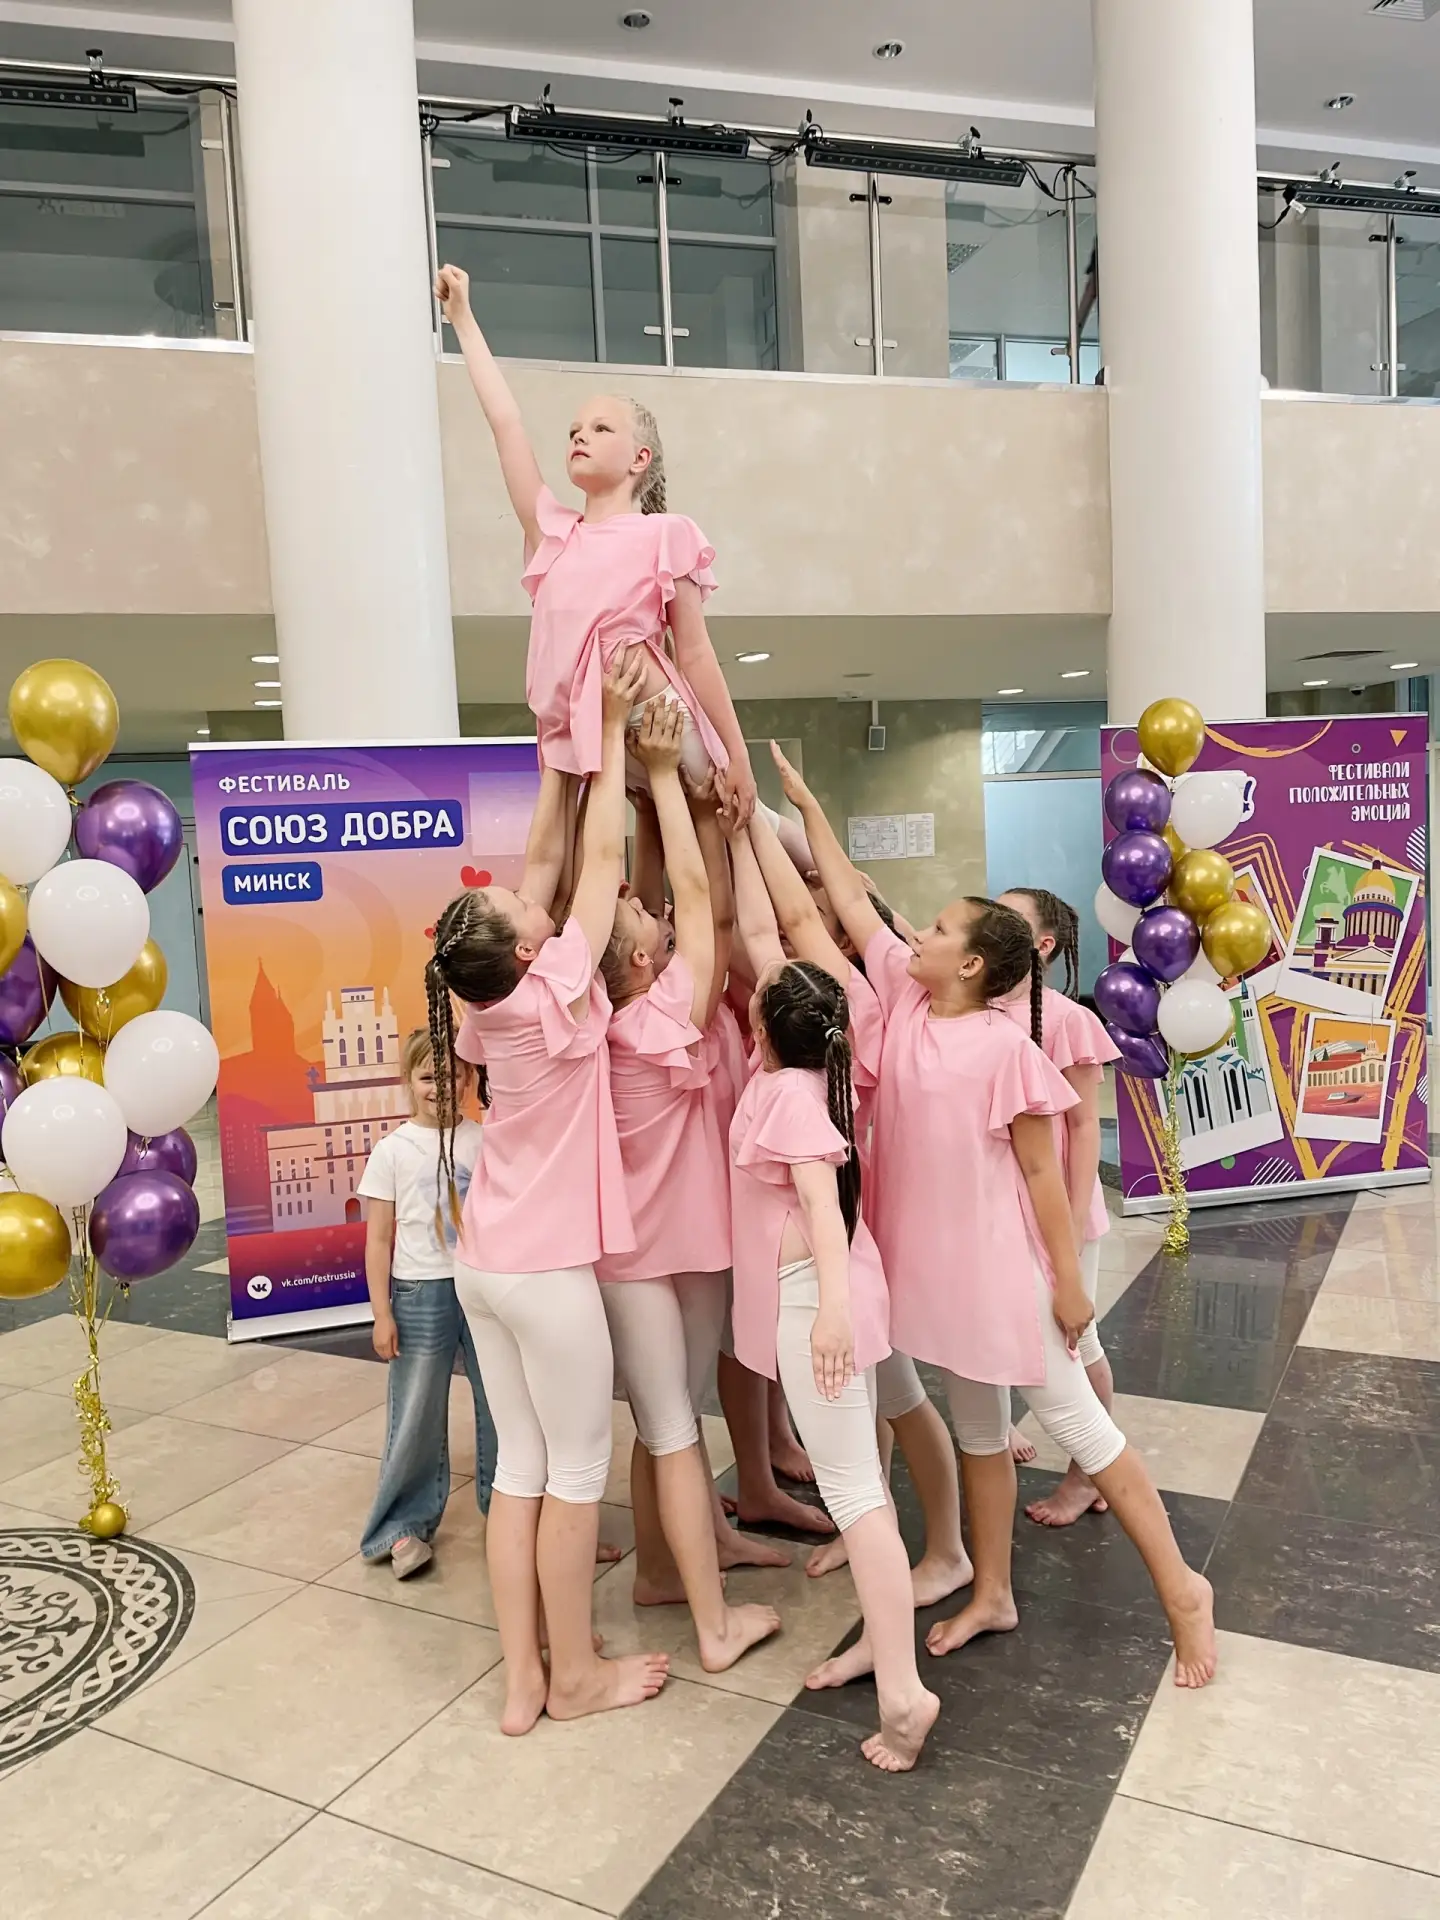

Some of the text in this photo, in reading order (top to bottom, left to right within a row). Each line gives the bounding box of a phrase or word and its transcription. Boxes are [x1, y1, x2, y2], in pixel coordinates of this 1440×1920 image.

[1328, 761, 1410, 780] ФЕСТИВАЛИ
[218, 773, 351, 793] ФЕСТИВАЛЬ
[1289, 782, 1410, 803] ПОЛОЖИТЕЛЬНЫХ
[1351, 802, 1411, 823] ЭМОЦИЙ
[226, 809, 456, 847] СОЮЗ ДОБРА
[233, 872, 312, 893] МИНСК
[281, 1270, 356, 1287] vk.com/festrussia
